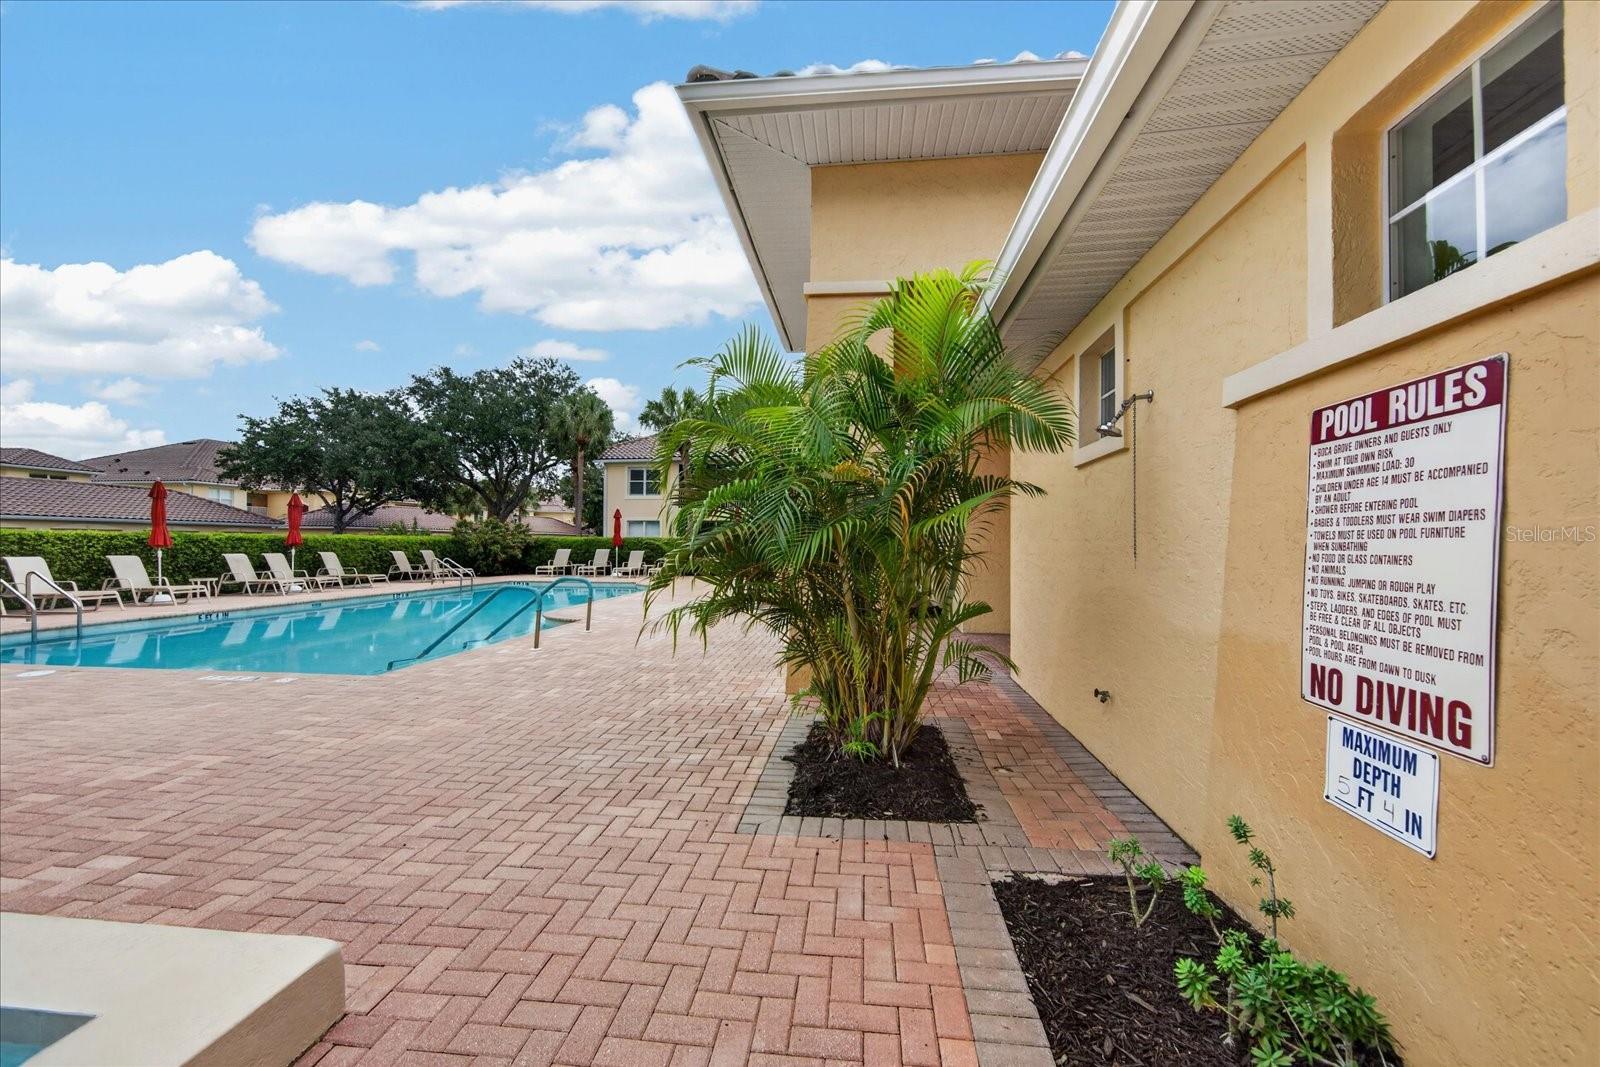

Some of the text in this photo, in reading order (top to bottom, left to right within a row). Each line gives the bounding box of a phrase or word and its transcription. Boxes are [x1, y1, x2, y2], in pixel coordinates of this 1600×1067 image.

[1320, 365, 1487, 440] POOL RULES
[1318, 422, 1452, 457] BOCA GROVE OWNERS AND GUESTS ONLY
[1316, 471, 1344, 480] MAXIMUM
[1346, 463, 1380, 476] SWIMMING
[1405, 457, 1414, 468] 30
[1317, 460, 1332, 469] SWIM
[1343, 454, 1358, 465] YOUR
[1361, 452, 1375, 462] OWN
[1378, 448, 1393, 459] RISK
[1316, 462, 1488, 493] CHILDREN UNDER AGE 14 MUST BE ACCOMPANIED
[1315, 492, 1351, 504] BY AN ADULT
[1315, 498, 1418, 515] SHOWER BEFORE ENTERING POOL
[1314, 518, 1334, 527] BABIES
[1343, 514, 1374, 526] TODDLERS
[1376, 514, 1396, 524] MUST
[1399, 512, 1420, 523] WEAR
[1423, 511, 1445, 522] SWIM
[1449, 508, 1486, 521] DIAPERS
[1314, 526, 1465, 540] TOWELS MUST BE USED ON POOL FURNITURE
[1314, 542, 1368, 551] WHEN SUNBATHING
[1312, 554, 1413, 566] NO FOOD OR GLASS CONTAINERS
[1312, 565, 1346, 575] NO ANIMALS
[1311, 576, 1318, 585] NO
[1348, 579, 1376, 590] JUMPING
[1378, 580, 1387, 590] OR
[1390, 581, 1414, 593] ROUGH
[1417, 584, 1436, 595] PLAY
[1311, 589, 1318, 597] NO
[1449, 602, 1468, 615] ETC.
[1310, 611, 1421, 638] BE FREE & CLEAR OF ALL OBJECTS
[1362, 608, 1374, 618] AND
[1377, 610, 1400, 622] EDGES
[1402, 613, 1412, 623] OF
[1414, 614, 1433, 627] POOL
[1437, 618, 1462, 631] MUST
[1309, 624, 1484, 666] PERSONAL BELONGINGS MUST BE REMOVED FROM
[1309, 636, 1363, 655] POOL & POOL AREA
[1308, 647, 1436, 685] POOL HOURS ARE FROM DAWN TO DUSK
[1310, 663, 1472, 749] NO DIVING
[1342, 727, 1417, 776] MAXIMUM
[1353, 758, 1400, 798] DEPTH
[1338, 775, 1422, 839] 5 FT 4 IN
